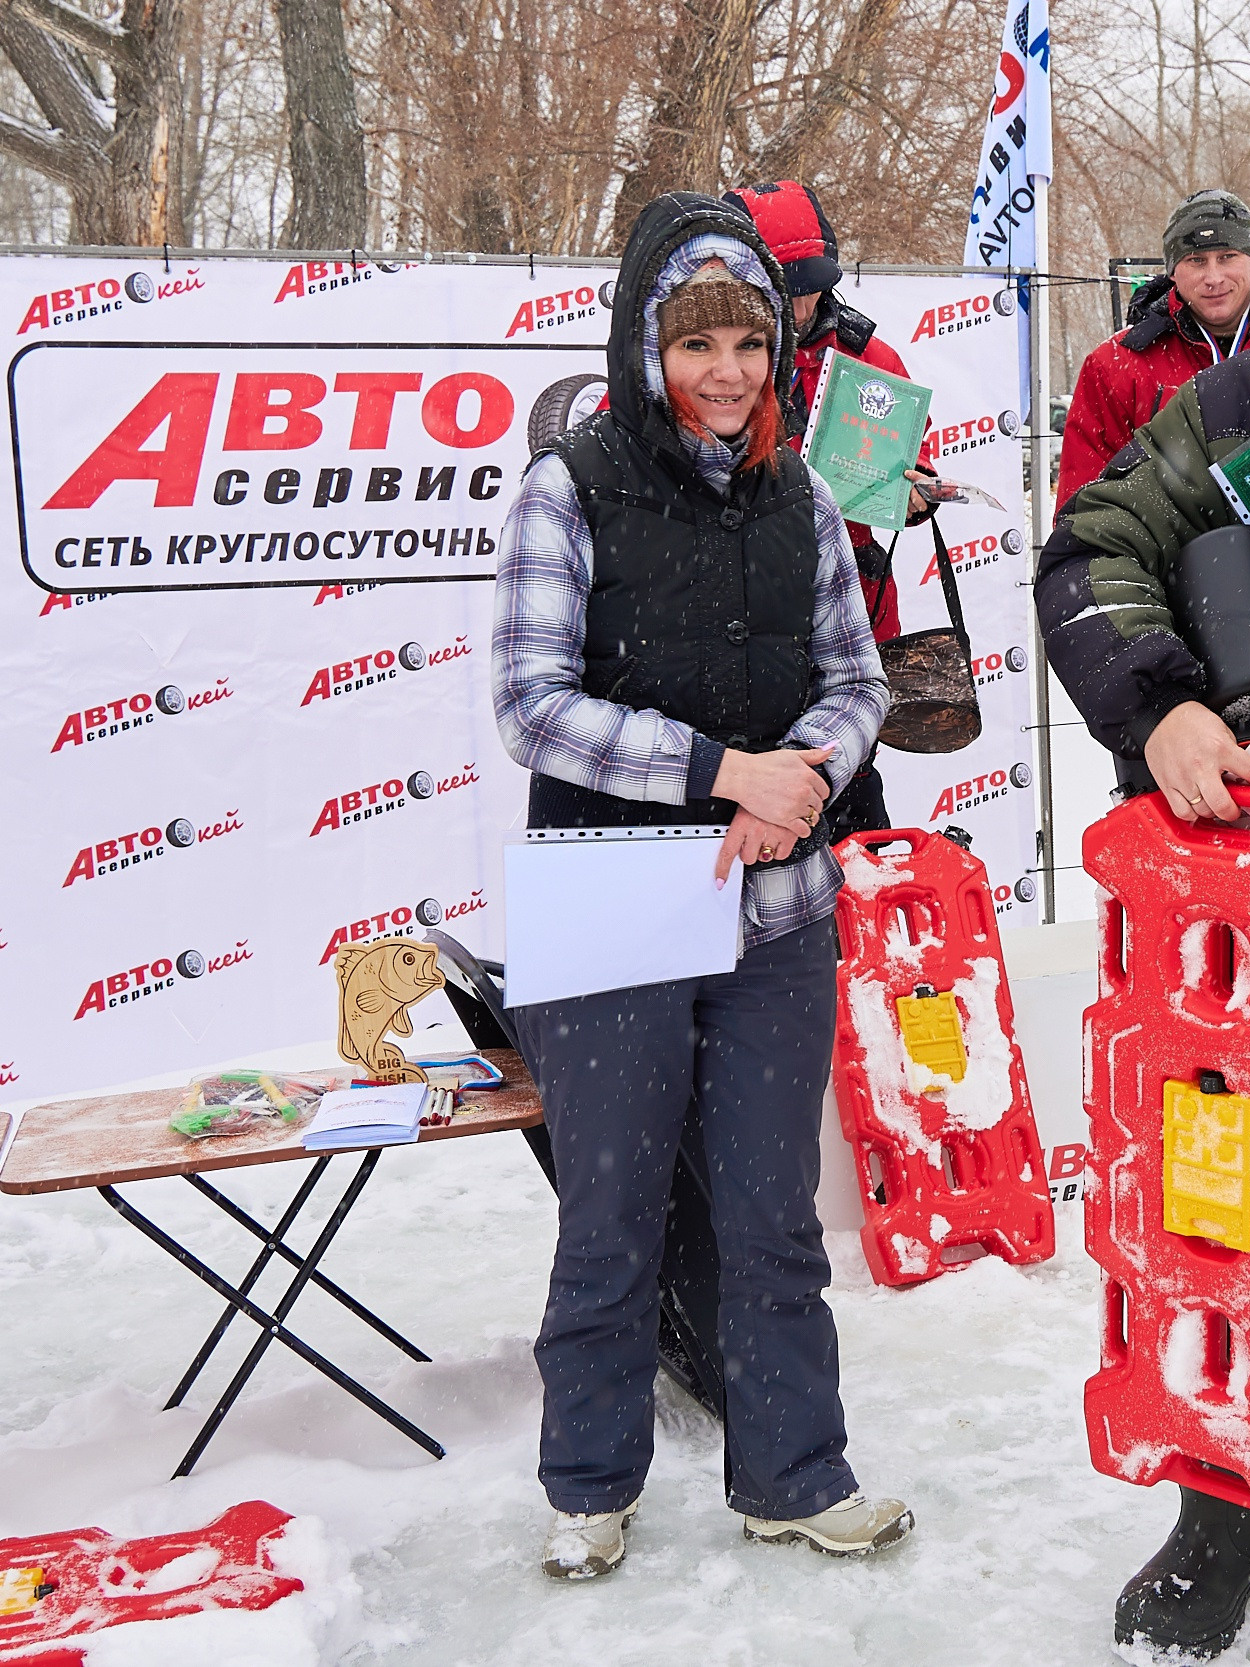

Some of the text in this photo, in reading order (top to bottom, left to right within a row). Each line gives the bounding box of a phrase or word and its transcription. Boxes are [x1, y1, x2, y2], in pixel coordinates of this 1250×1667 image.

[158, 268, 206, 300] кей
[308, 268, 372, 295] сервис
[53, 300, 123, 326] сервис
[537, 307, 596, 330] сервис
[939, 313, 991, 336] сервис
[862, 403, 886, 420] СДС
[942, 434, 996, 457] сервис
[213, 464, 503, 508] сервис
[54, 536, 152, 570] СЕТЬ
[955, 553, 999, 574] ервис
[429, 635, 472, 666] кей
[187, 677, 234, 710] кей
[333, 667, 397, 697] сервис
[85, 712, 154, 742] сервис
[437, 763, 480, 795] кей
[342, 797, 405, 827] сервис
[956, 787, 1008, 812] сервис
[198, 809, 244, 842] кей
[96, 845, 164, 877] сервис
[445, 888, 488, 921] кей
[208, 939, 254, 973] кей
[107, 977, 175, 1008] сервис
[376, 1072, 406, 1083] FISH
[377, 1058, 401, 1070] BIG
